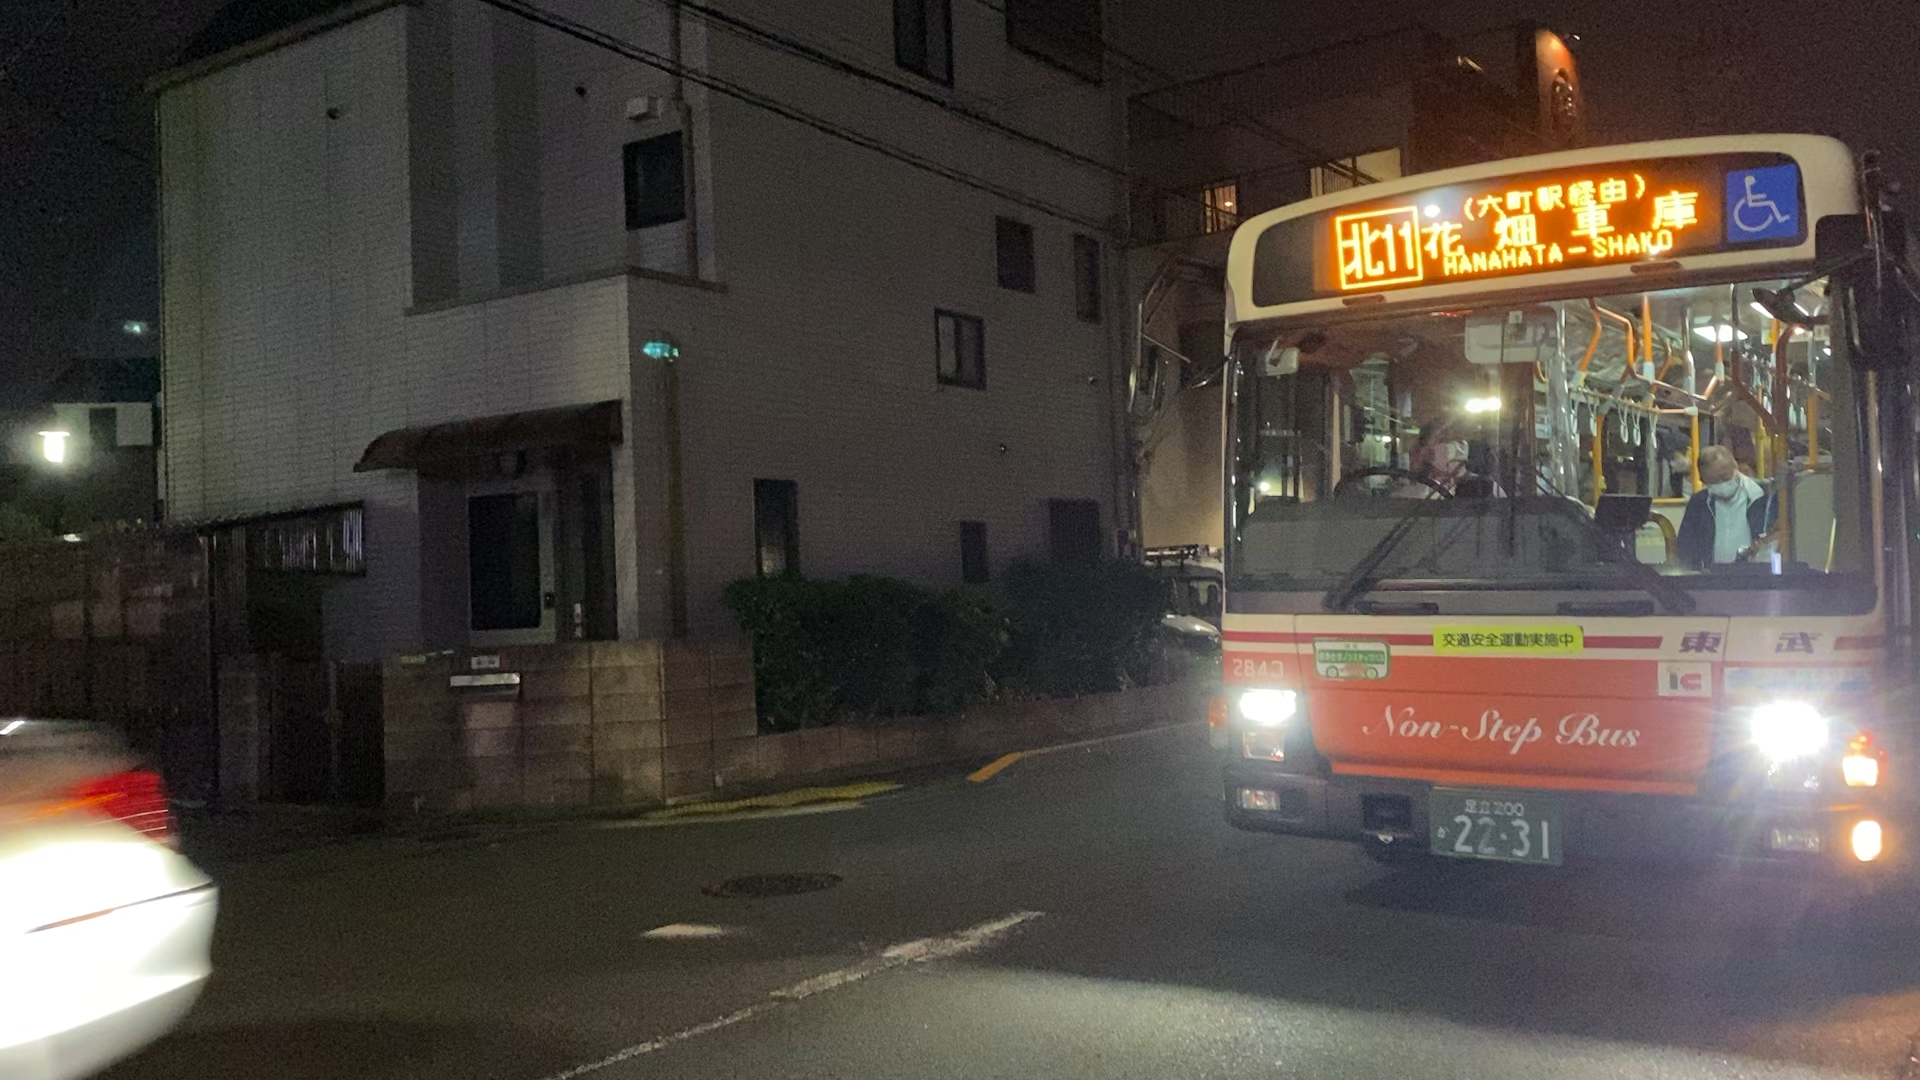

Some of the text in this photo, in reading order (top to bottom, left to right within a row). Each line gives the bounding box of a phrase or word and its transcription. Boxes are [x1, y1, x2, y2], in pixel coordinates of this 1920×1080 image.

[1342, 220, 1416, 279] 北11
[1442, 632, 1575, 648] 交通安全運動実施中
[1679, 631, 1822, 655] 東武
[1232, 657, 1284, 678] 2843
[1362, 704, 1641, 755] Non-Step Bus
